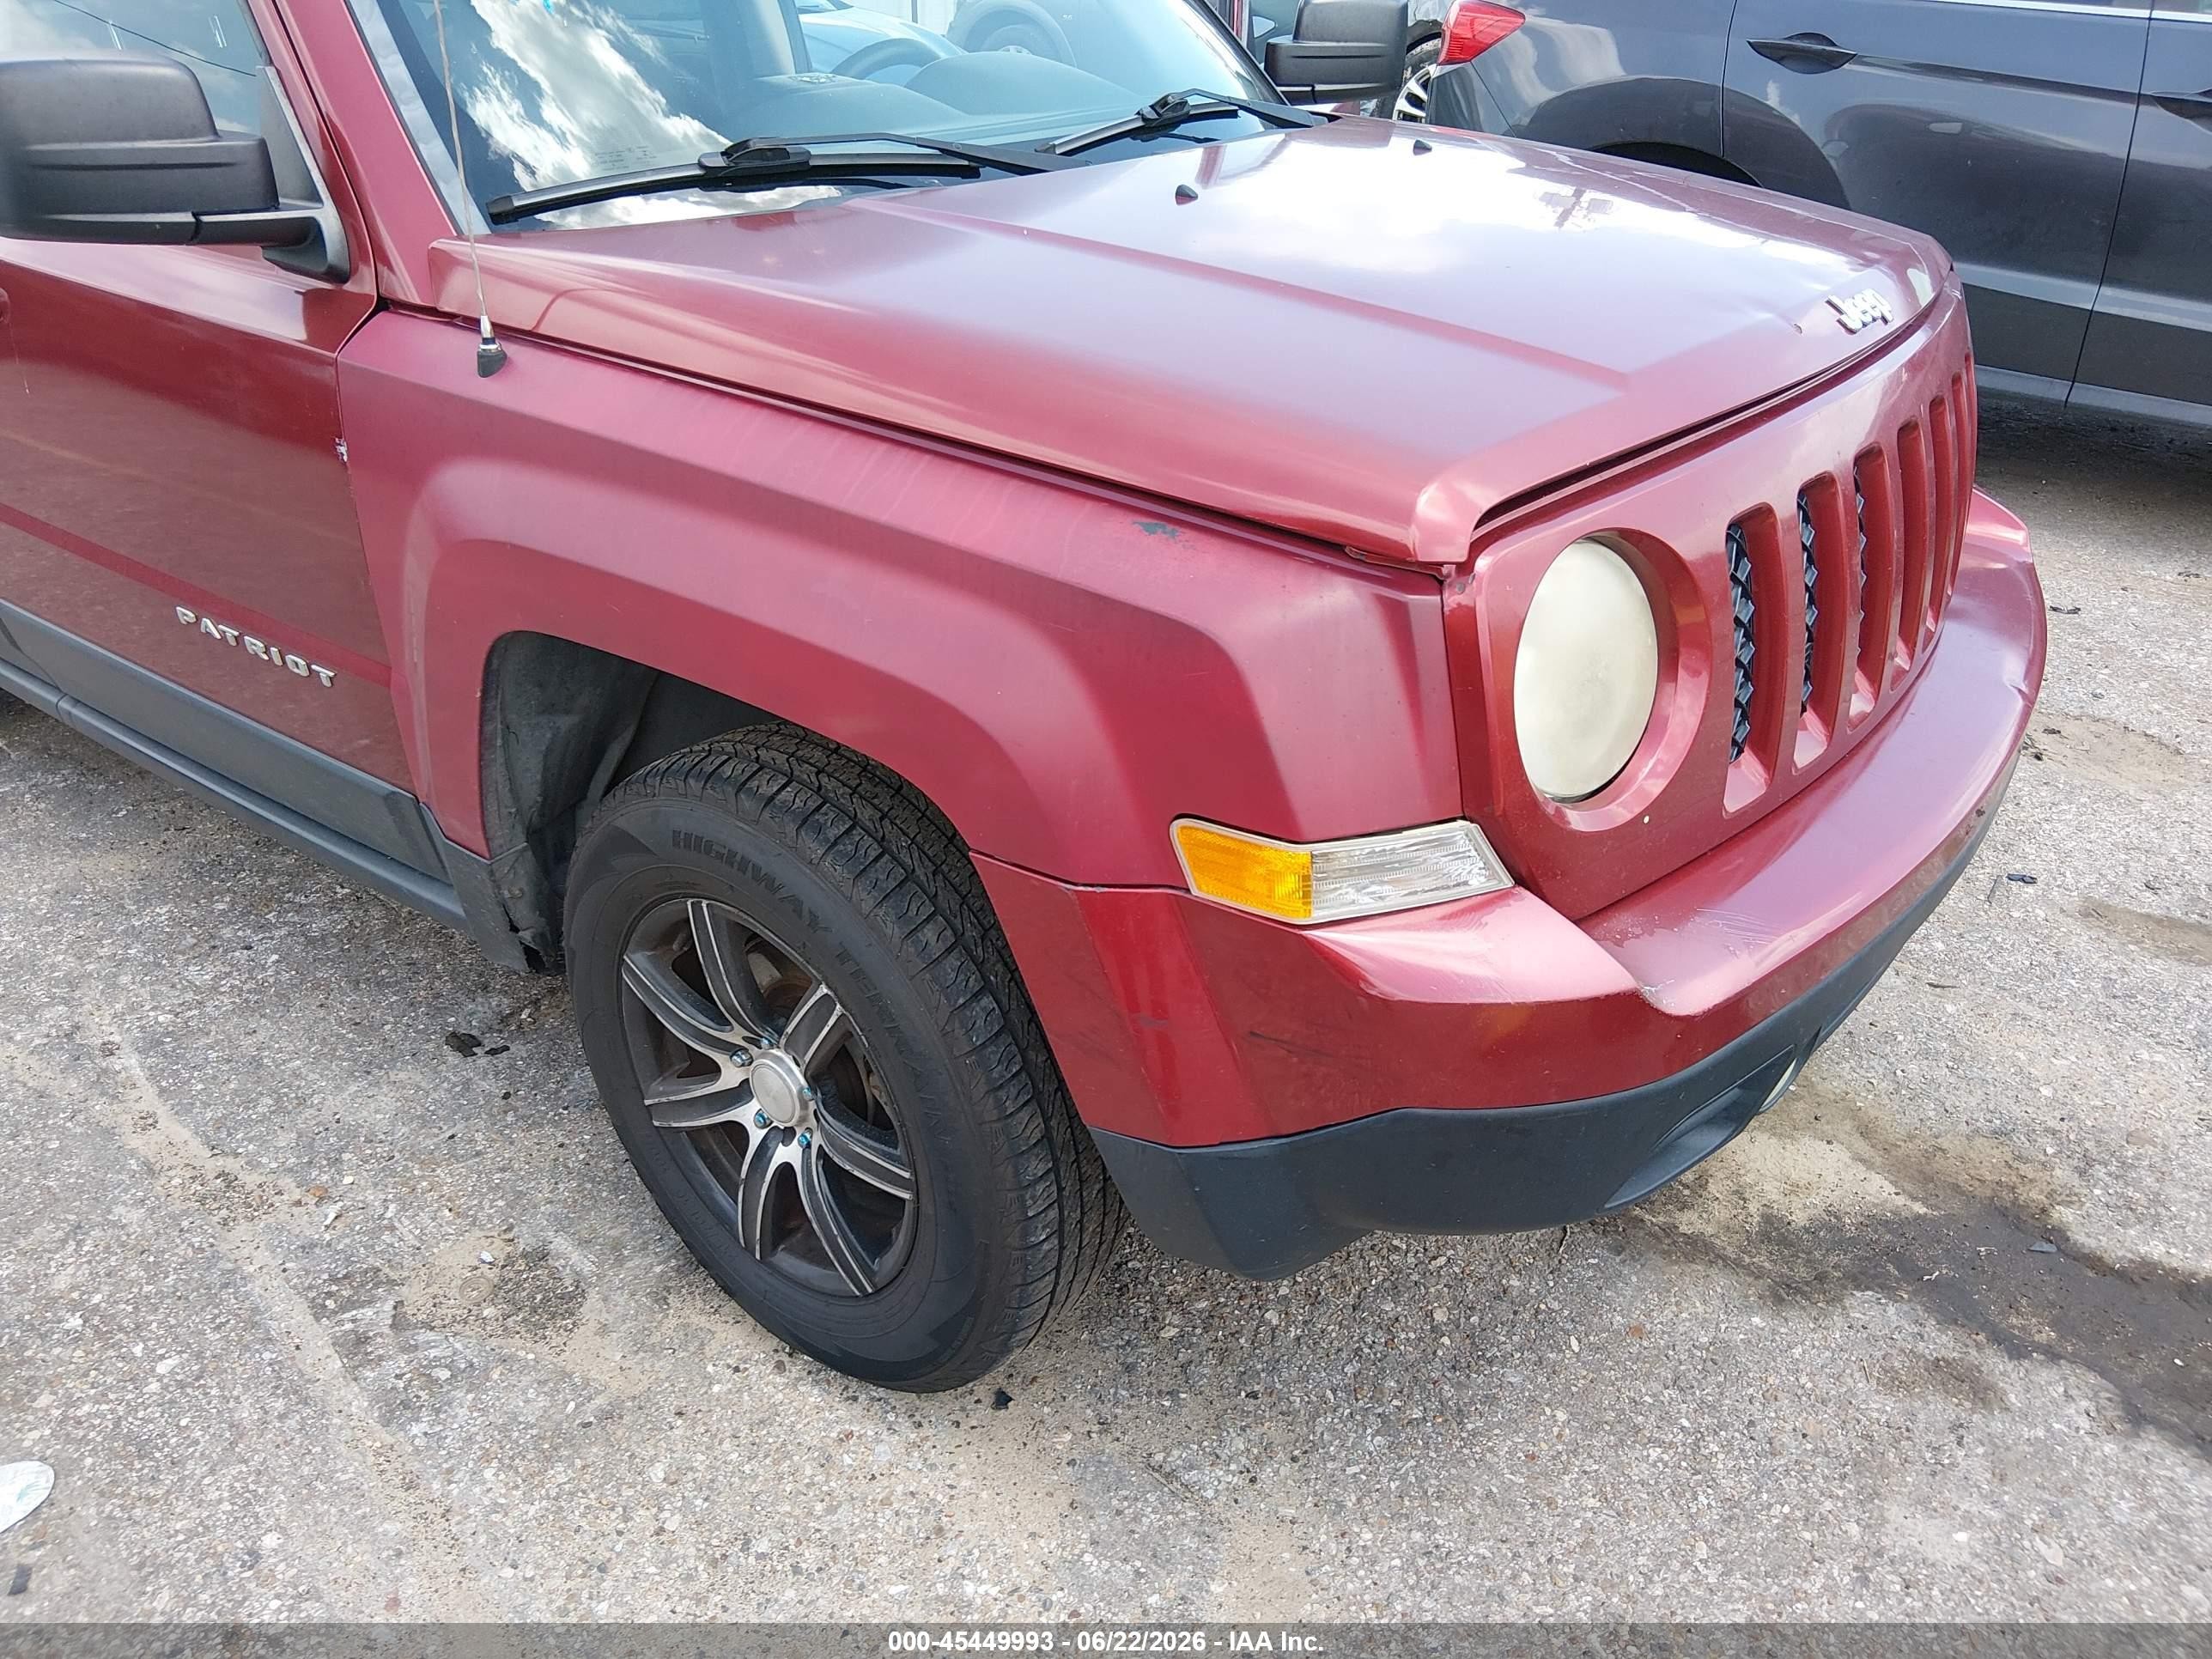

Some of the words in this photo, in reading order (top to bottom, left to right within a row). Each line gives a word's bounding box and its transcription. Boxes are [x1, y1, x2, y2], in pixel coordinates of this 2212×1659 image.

[1825, 289, 1894, 335] Jeep
[176, 605, 337, 688] PATRIOT
[672, 829, 833, 933] HIGHWAY
